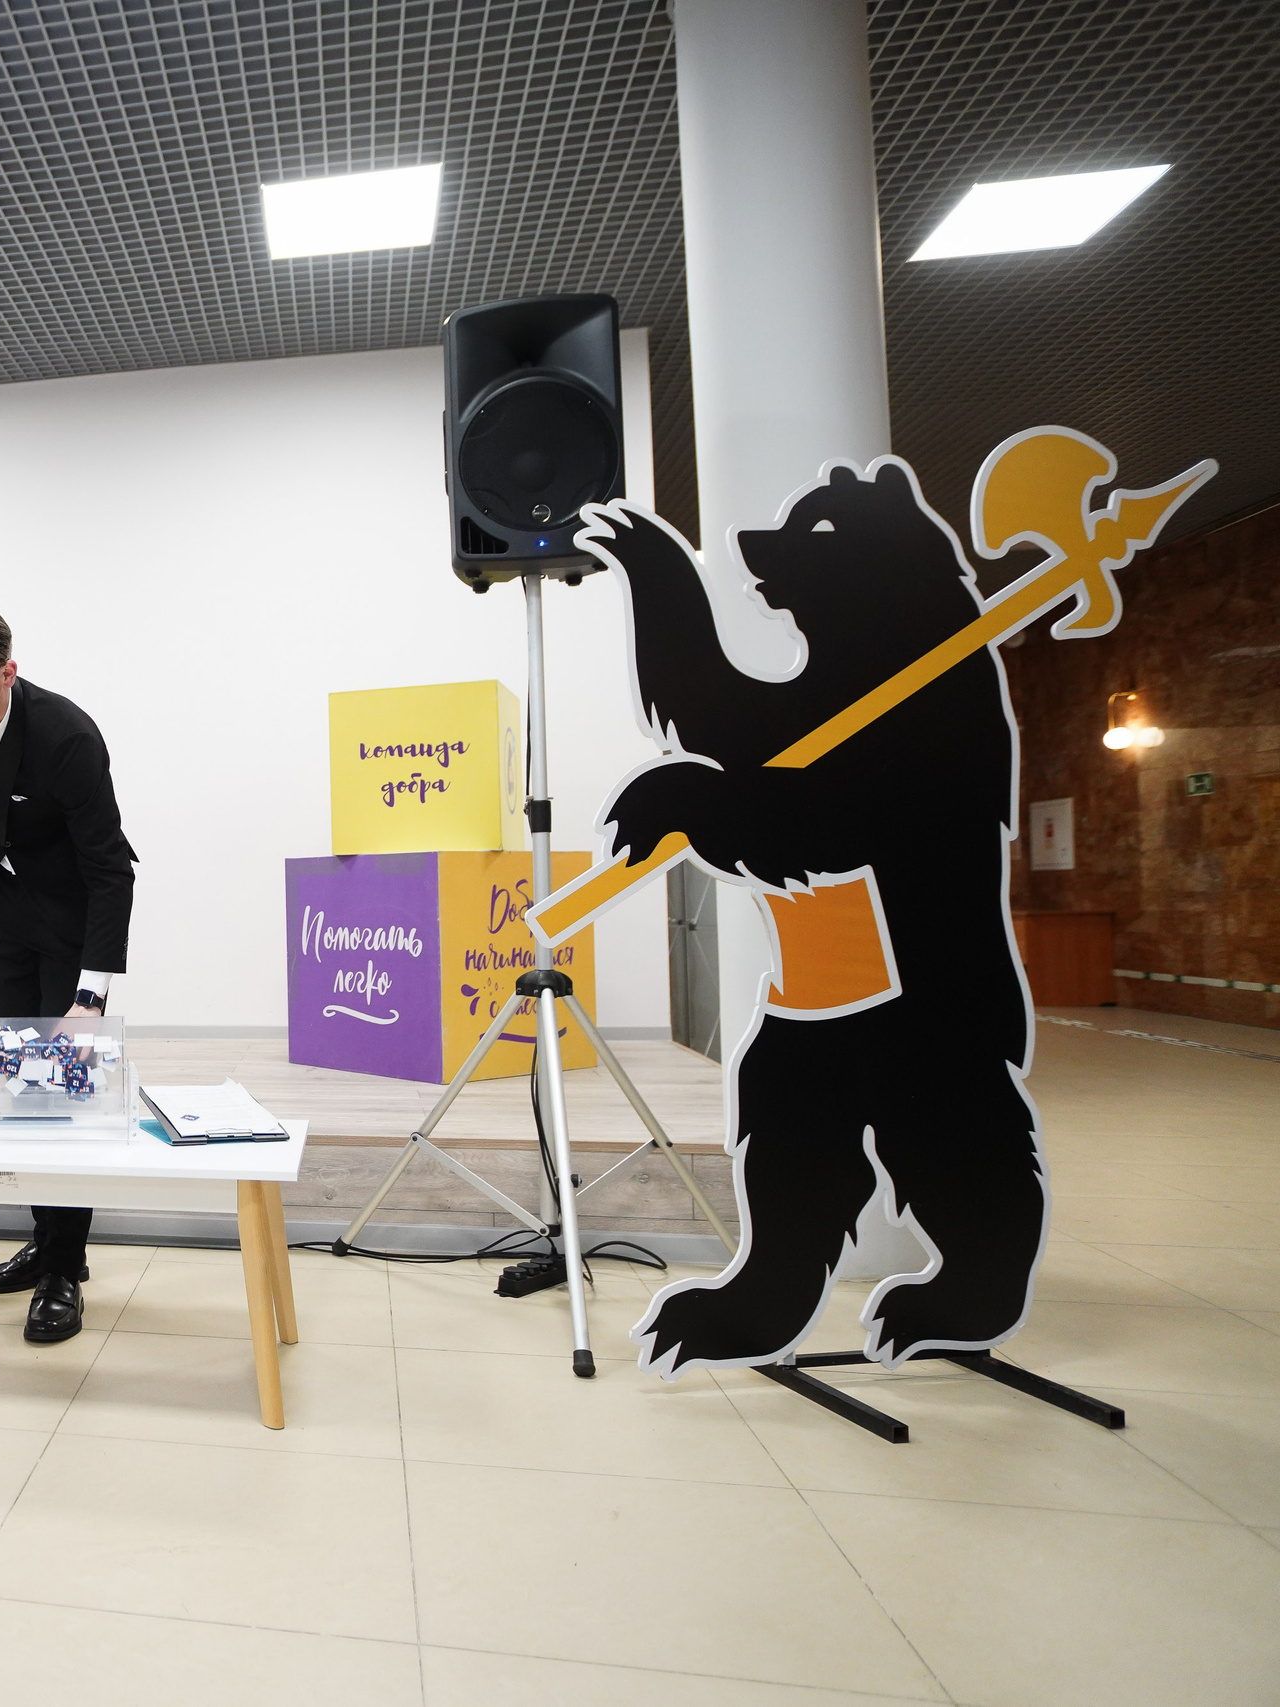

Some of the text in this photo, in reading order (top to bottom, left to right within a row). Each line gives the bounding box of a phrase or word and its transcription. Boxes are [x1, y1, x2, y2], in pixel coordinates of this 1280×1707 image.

[359, 741, 470, 768] команда
[381, 772, 451, 807] добра
[487, 878, 535, 939] Доб
[301, 905, 423, 963] Помогать
[465, 943, 574, 971] начинася
[333, 960, 393, 1006] легко
